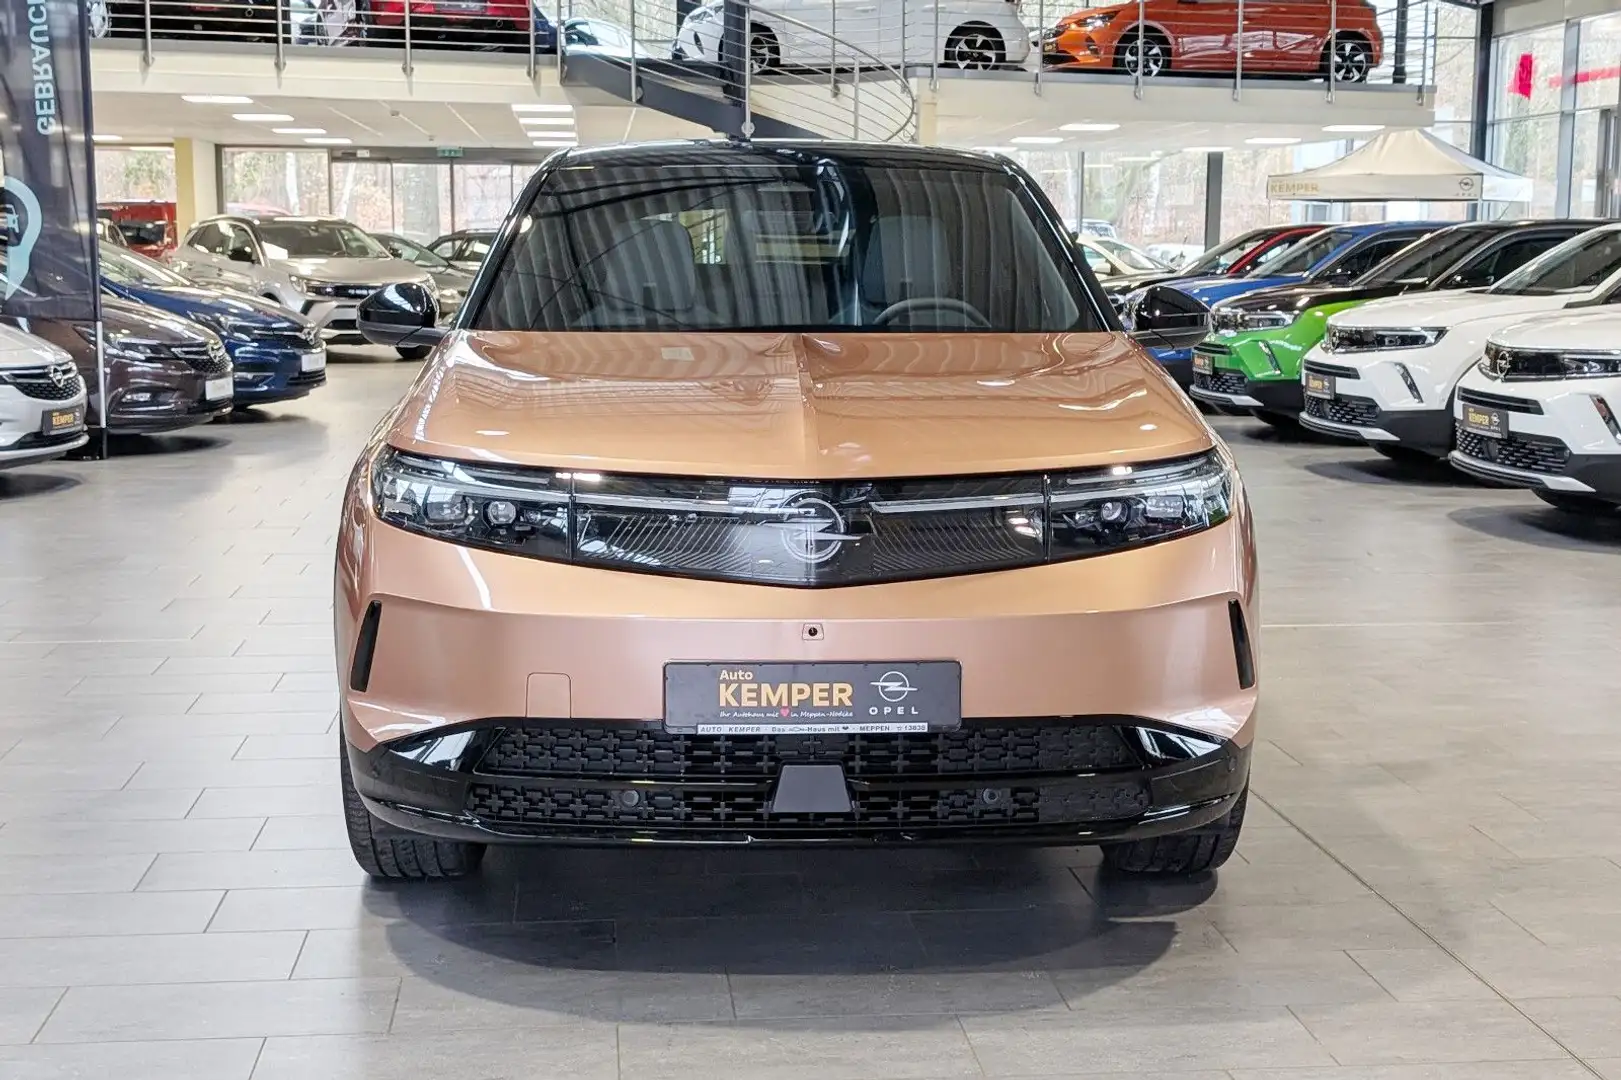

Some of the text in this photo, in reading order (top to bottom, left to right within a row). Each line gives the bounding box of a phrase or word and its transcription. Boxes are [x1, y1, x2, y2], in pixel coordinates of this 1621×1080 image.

[1270, 182, 1320, 193] KEMPER
[719, 669, 753, 680] Auto
[719, 683, 853, 707] KEMPER
[868, 706, 919, 715] OPEL
